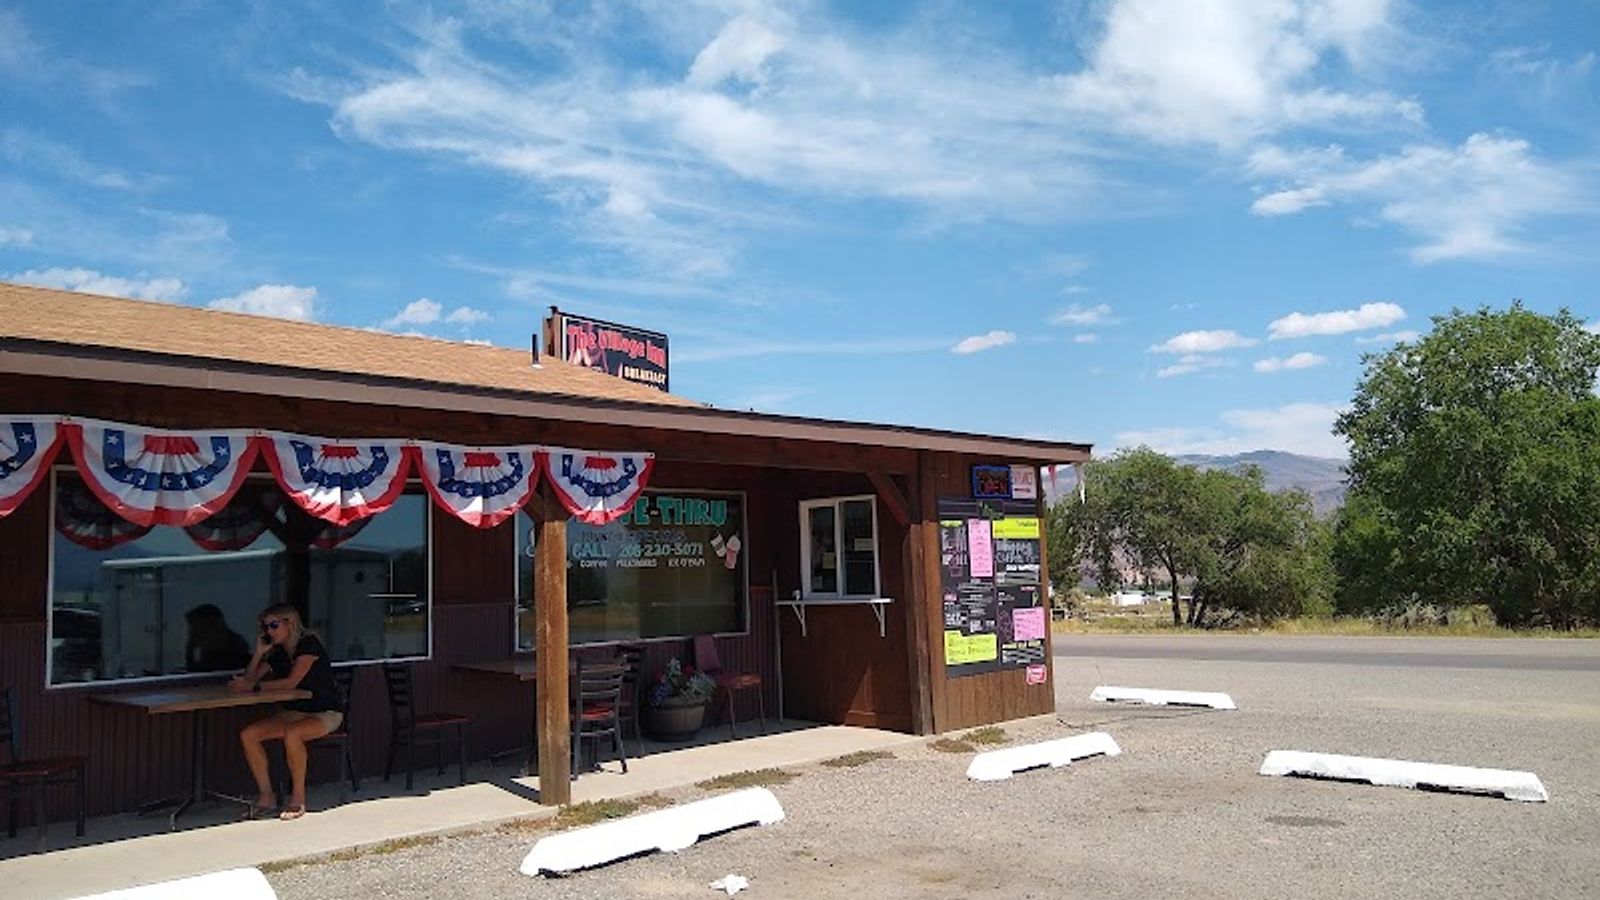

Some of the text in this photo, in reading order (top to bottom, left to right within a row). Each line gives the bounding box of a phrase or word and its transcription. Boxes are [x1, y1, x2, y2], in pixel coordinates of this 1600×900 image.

[567, 324, 666, 369] The Village Inn
[620, 496, 728, 527] E-THRU
[572, 542, 611, 558] CALL
